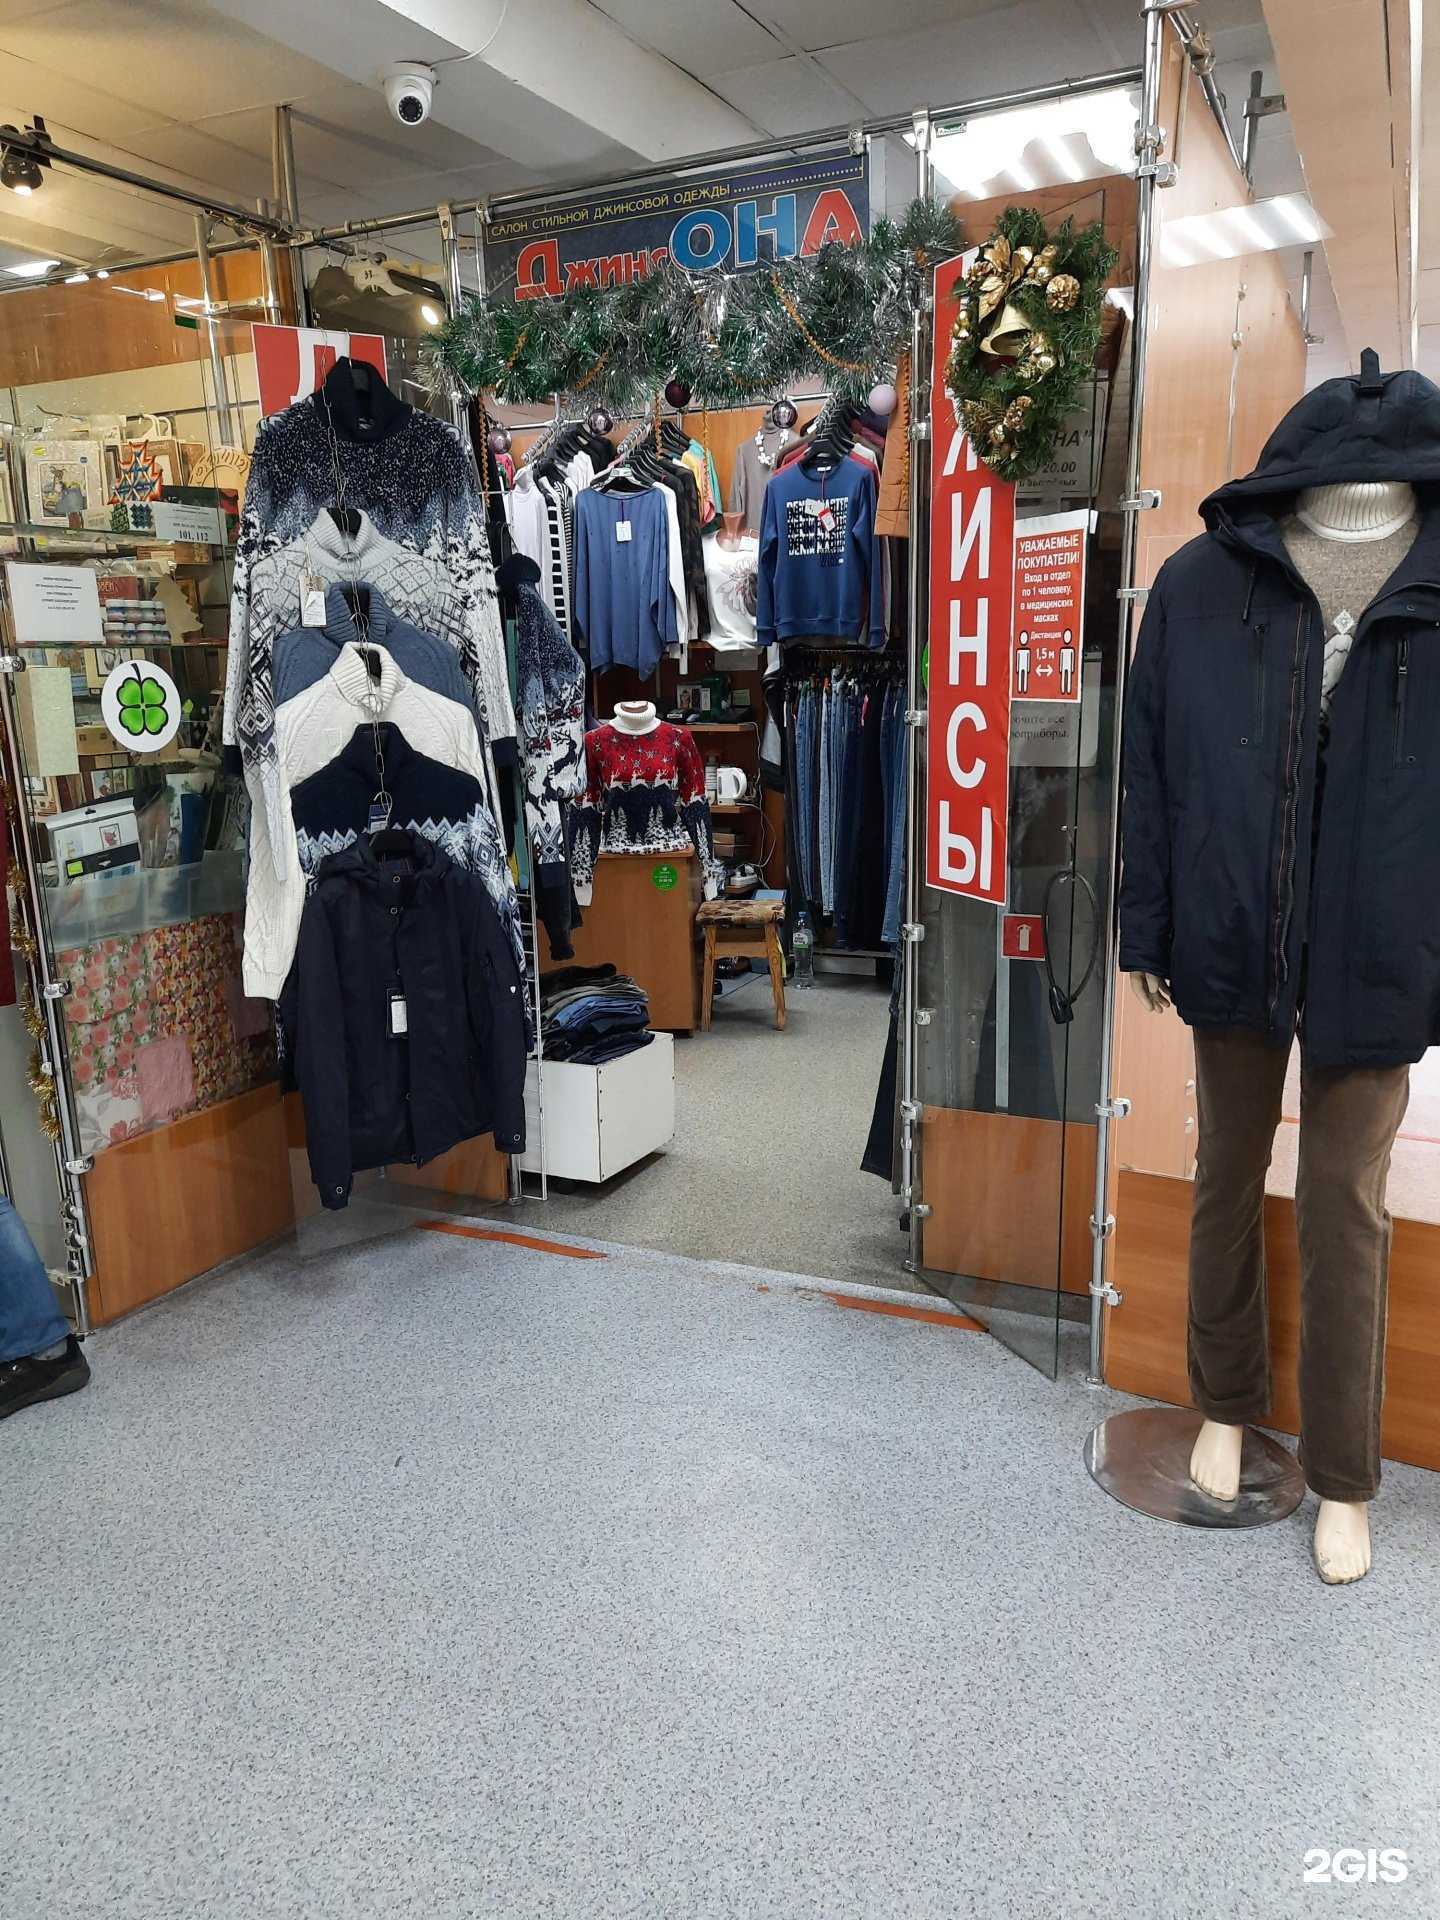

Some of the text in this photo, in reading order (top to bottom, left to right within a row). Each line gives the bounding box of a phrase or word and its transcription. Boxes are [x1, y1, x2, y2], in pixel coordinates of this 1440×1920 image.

[491, 184, 730, 237] САЛОН СТИЛЬНОЙ ДЖИНСОВОЙ ОДЕЖДЫ
[1020, 534, 1079, 553] УВАЖАЕМЫЕ
[1017, 551, 1080, 570] ПОКУПАТЕЛИ!
[1024, 573, 1042, 584] Вход
[1050, 570, 1071, 581] отдел
[1022, 588, 1031, 597] по
[1026, 599, 1073, 610] медицинских
[1033, 613, 1059, 623] масках
[1030, 630, 1062, 641] Дистанция
[1036, 647, 1055, 660] 1,5 м
